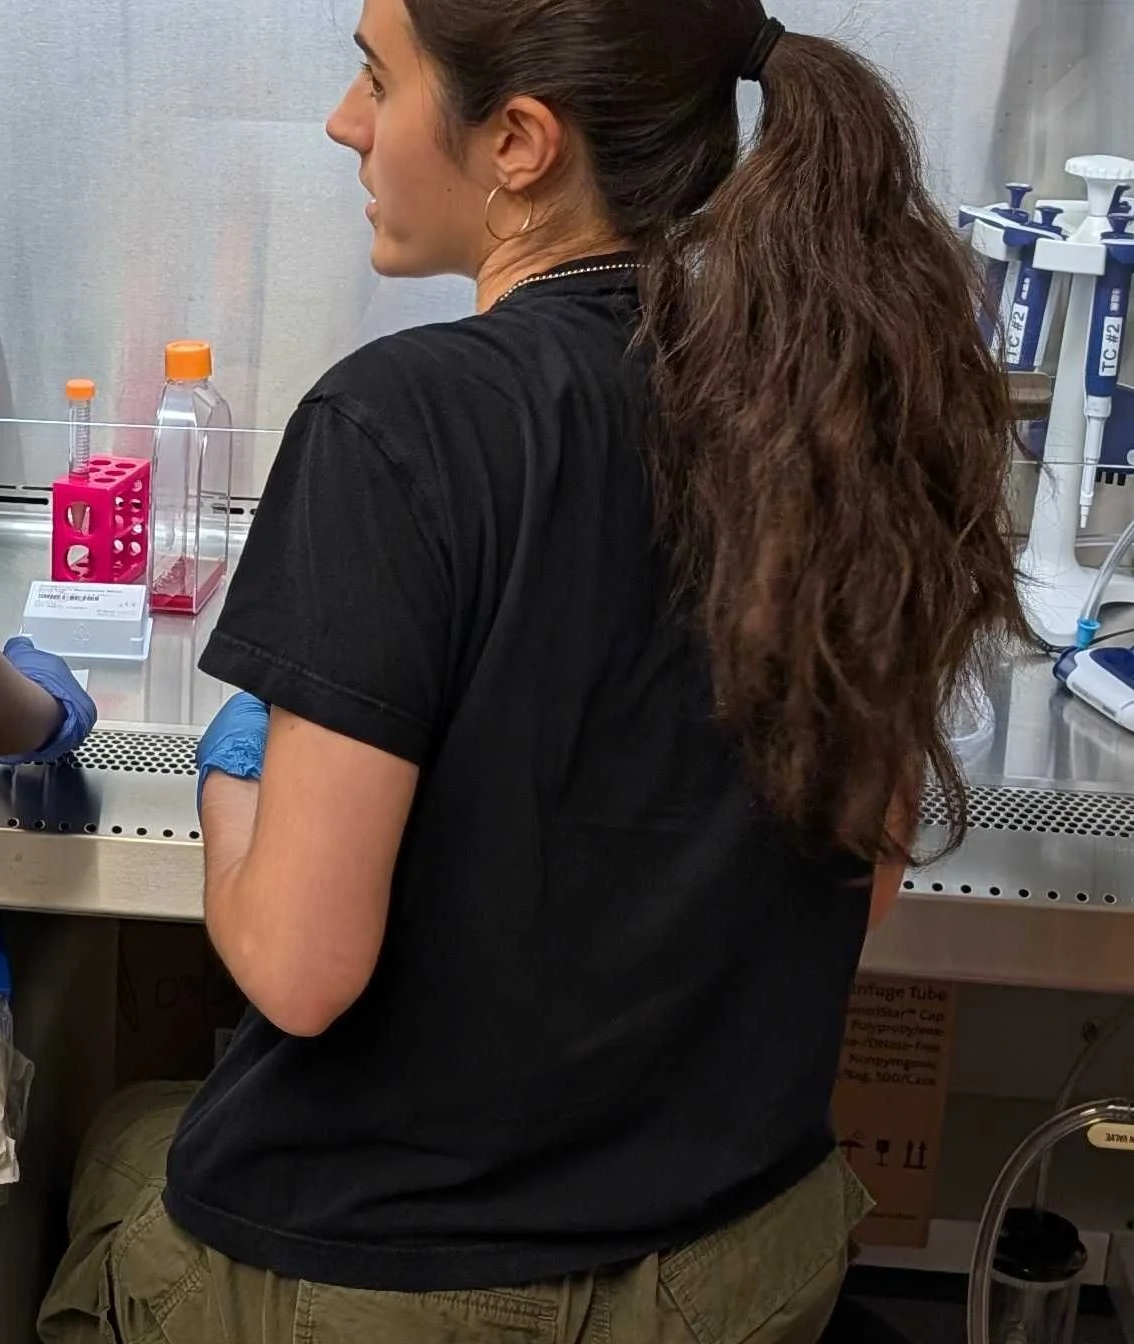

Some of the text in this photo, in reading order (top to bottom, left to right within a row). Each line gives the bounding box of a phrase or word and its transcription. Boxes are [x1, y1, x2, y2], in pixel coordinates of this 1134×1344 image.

[1106, 324, 1120, 344] #2
[1102, 348, 1116, 372] TC
[908, 986, 948, 1001] Tube
